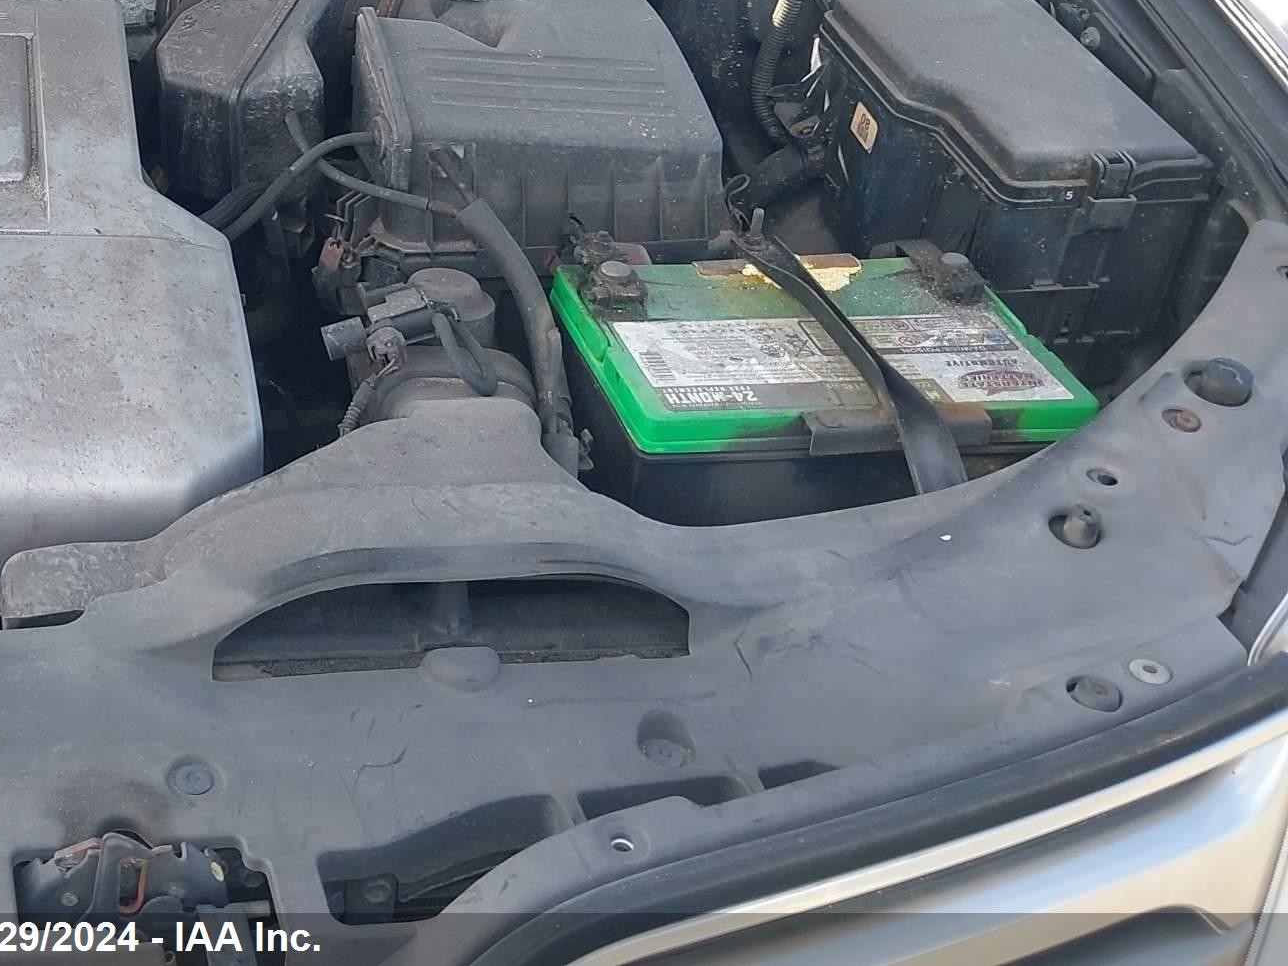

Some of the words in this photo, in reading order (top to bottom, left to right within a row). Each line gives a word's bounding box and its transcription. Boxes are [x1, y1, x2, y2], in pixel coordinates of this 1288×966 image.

[1064, 190, 1074, 201] 5
[944, 358, 1018, 367] AUTOMOTIVE
[664, 390, 758, 404] 24-MONTH
